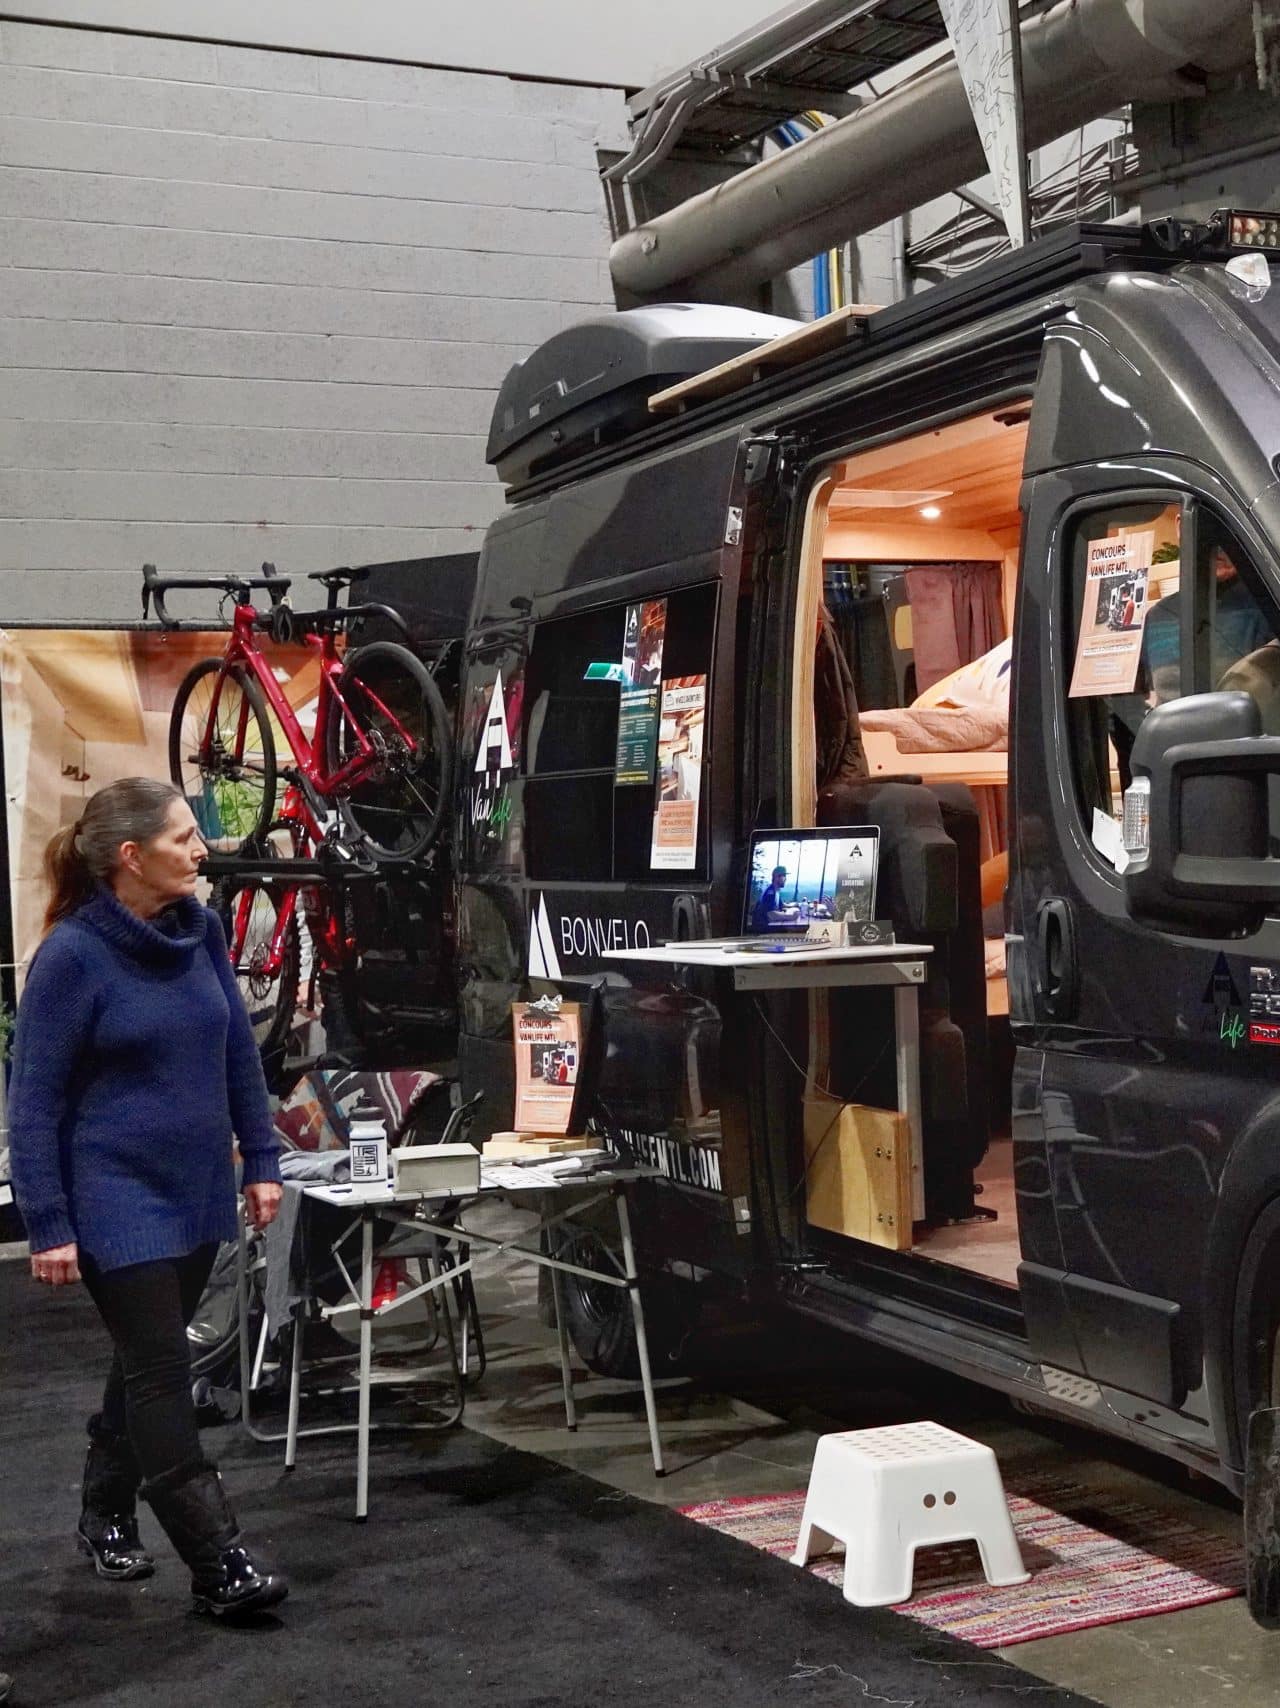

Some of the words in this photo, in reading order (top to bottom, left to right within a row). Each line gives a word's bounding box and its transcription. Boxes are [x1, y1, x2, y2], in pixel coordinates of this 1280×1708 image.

[1091, 544, 1126, 560] CONCOURS
[1090, 563, 1115, 577] VANLIFE
[1116, 561, 1128, 574] MTL
[560, 916, 650, 957] BONVELO
[519, 1019, 553, 1030] CONCOURS
[519, 1032, 544, 1042] VANLIFE
